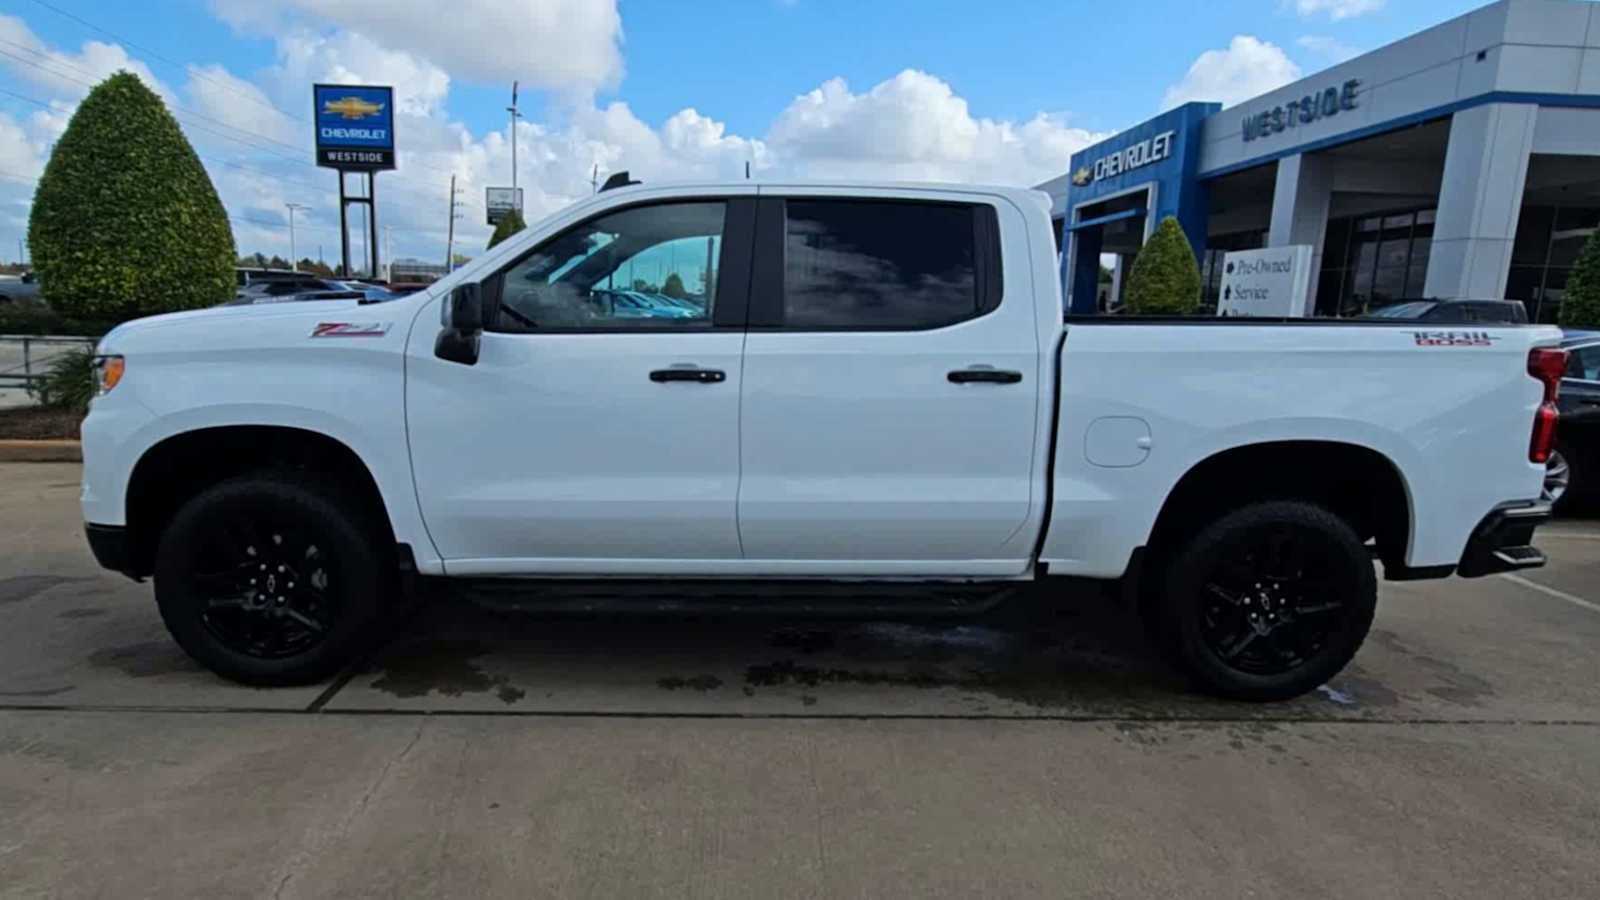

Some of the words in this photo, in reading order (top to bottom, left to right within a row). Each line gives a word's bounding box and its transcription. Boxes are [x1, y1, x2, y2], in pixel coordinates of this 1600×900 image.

[1242, 79, 1361, 142] WESTSIDE
[321, 127, 386, 139] CHEVROLET
[327, 151, 384, 162] WESTSIDE
[1094, 129, 1176, 181] CHEVROLET
[1236, 256, 1292, 274] Pre-Owned
[1233, 285, 1269, 300] Service
[1415, 338, 1492, 347] BOSS
